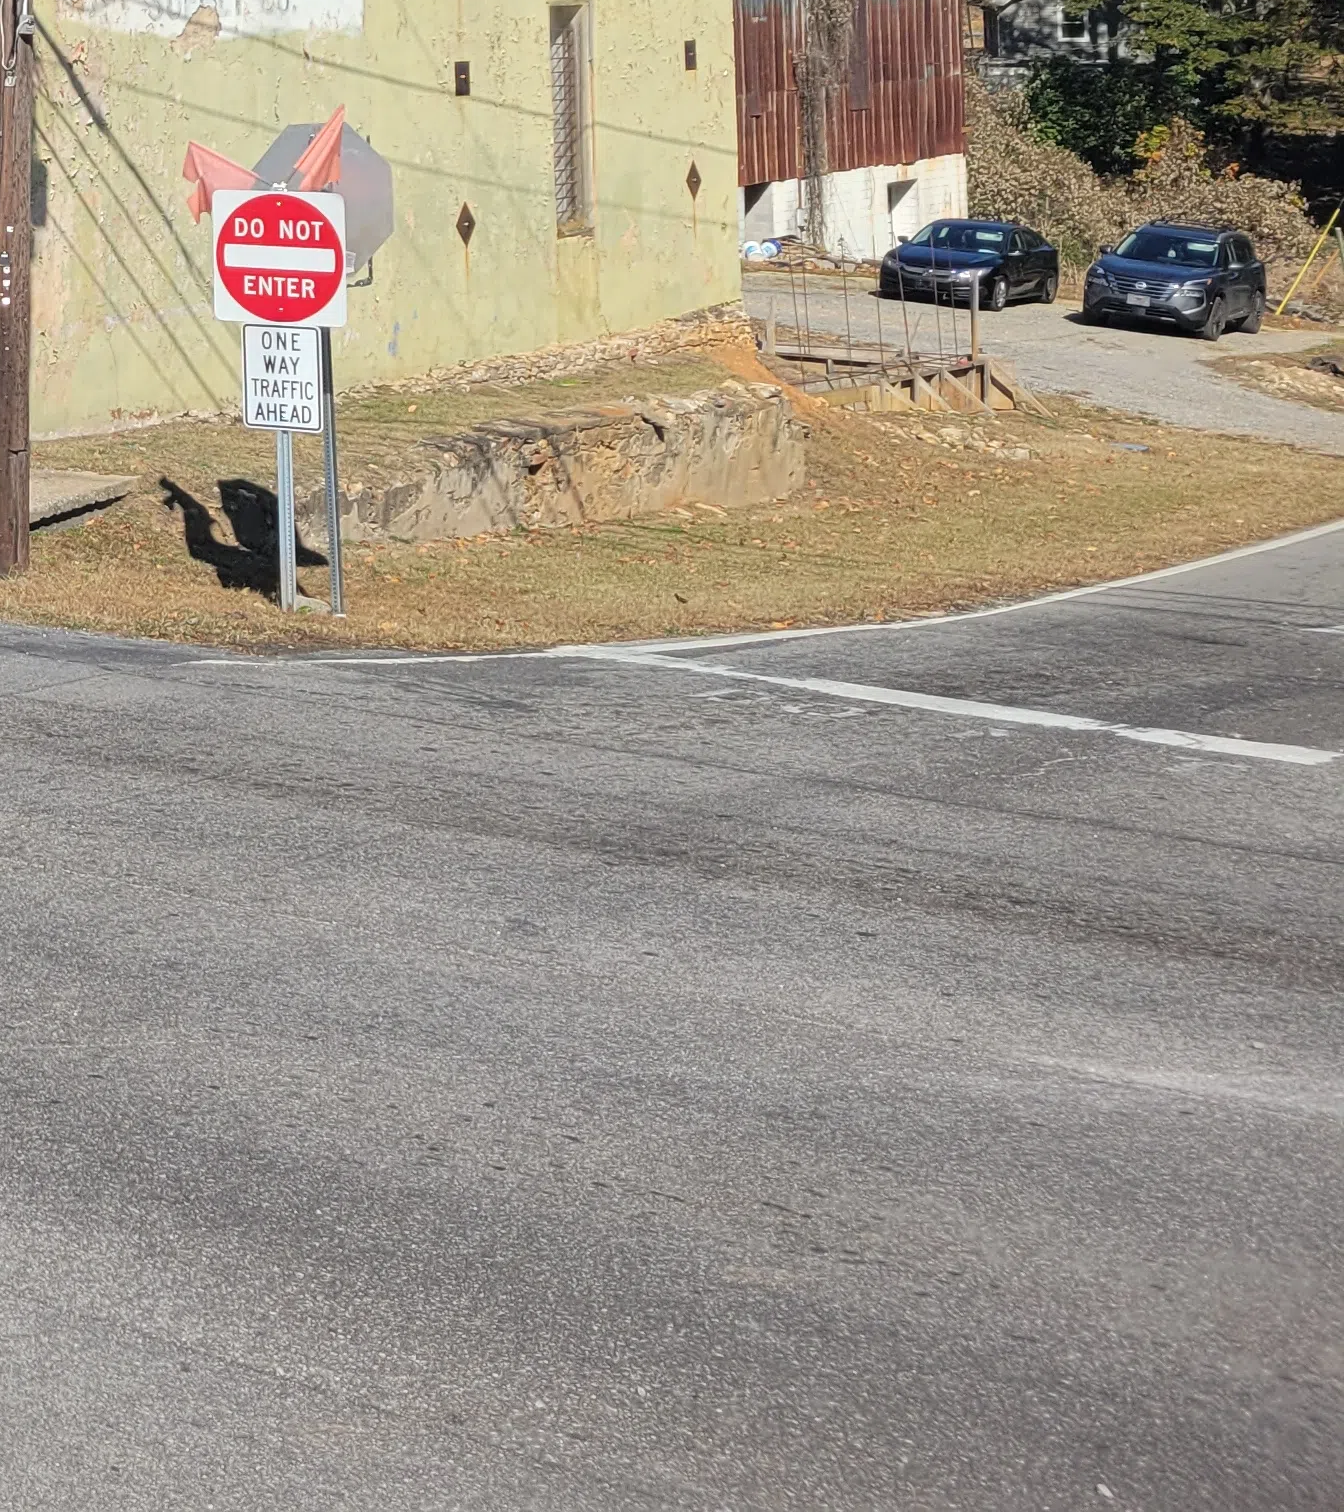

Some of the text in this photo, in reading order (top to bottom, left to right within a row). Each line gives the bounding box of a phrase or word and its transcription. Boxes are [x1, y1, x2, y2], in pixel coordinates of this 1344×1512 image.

[234, 217, 324, 242] DO NOT
[243, 275, 316, 299] ENTER
[262, 331, 301, 352] ONE
[263, 355, 301, 375] WAY
[251, 378, 314, 401] TRAFFIC
[254, 402, 313, 424] AHEAD
